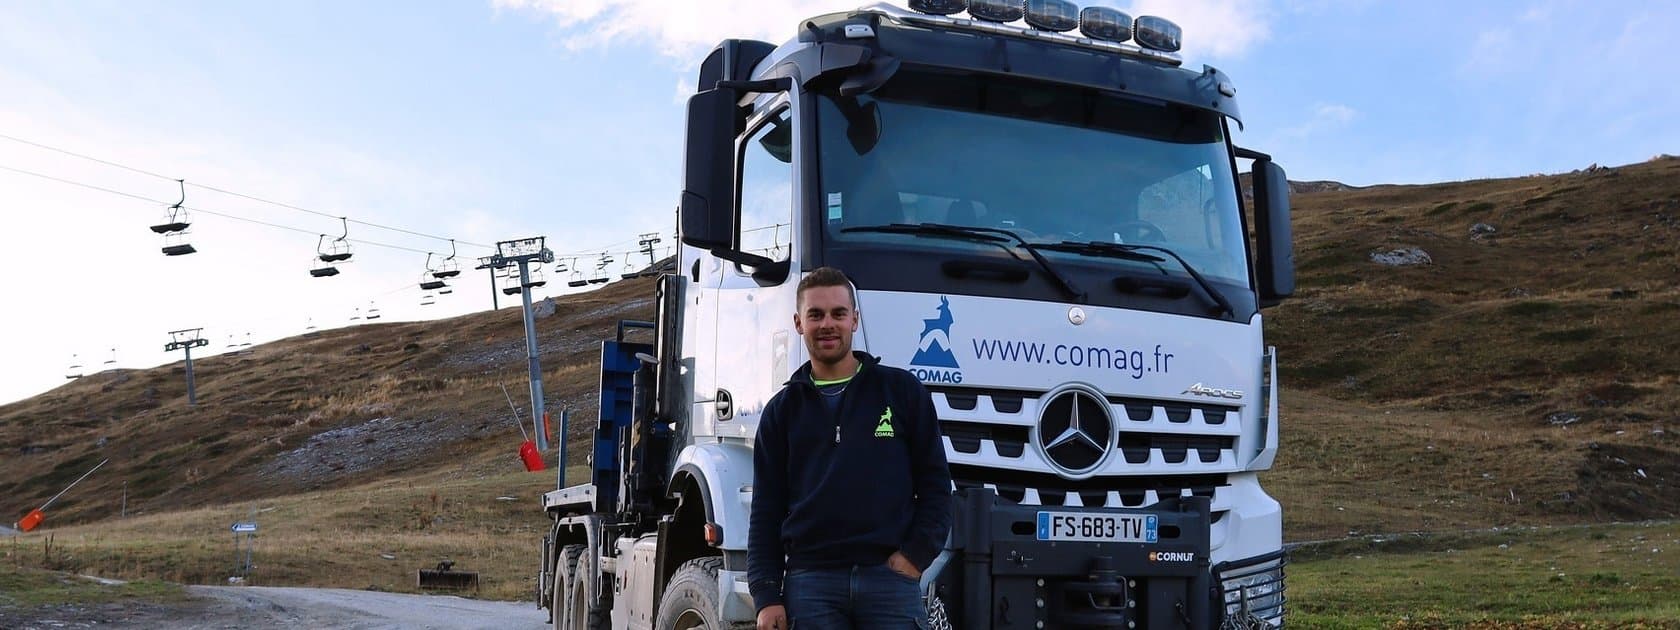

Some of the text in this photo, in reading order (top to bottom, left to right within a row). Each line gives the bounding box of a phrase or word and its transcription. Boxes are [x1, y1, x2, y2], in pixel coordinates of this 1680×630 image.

[972, 338, 1174, 380] www.comag.fr
[1053, 516, 1142, 538] FS-683-TV
[1146, 529, 1157, 539] 73
[1156, 551, 1194, 562] CORNUT
